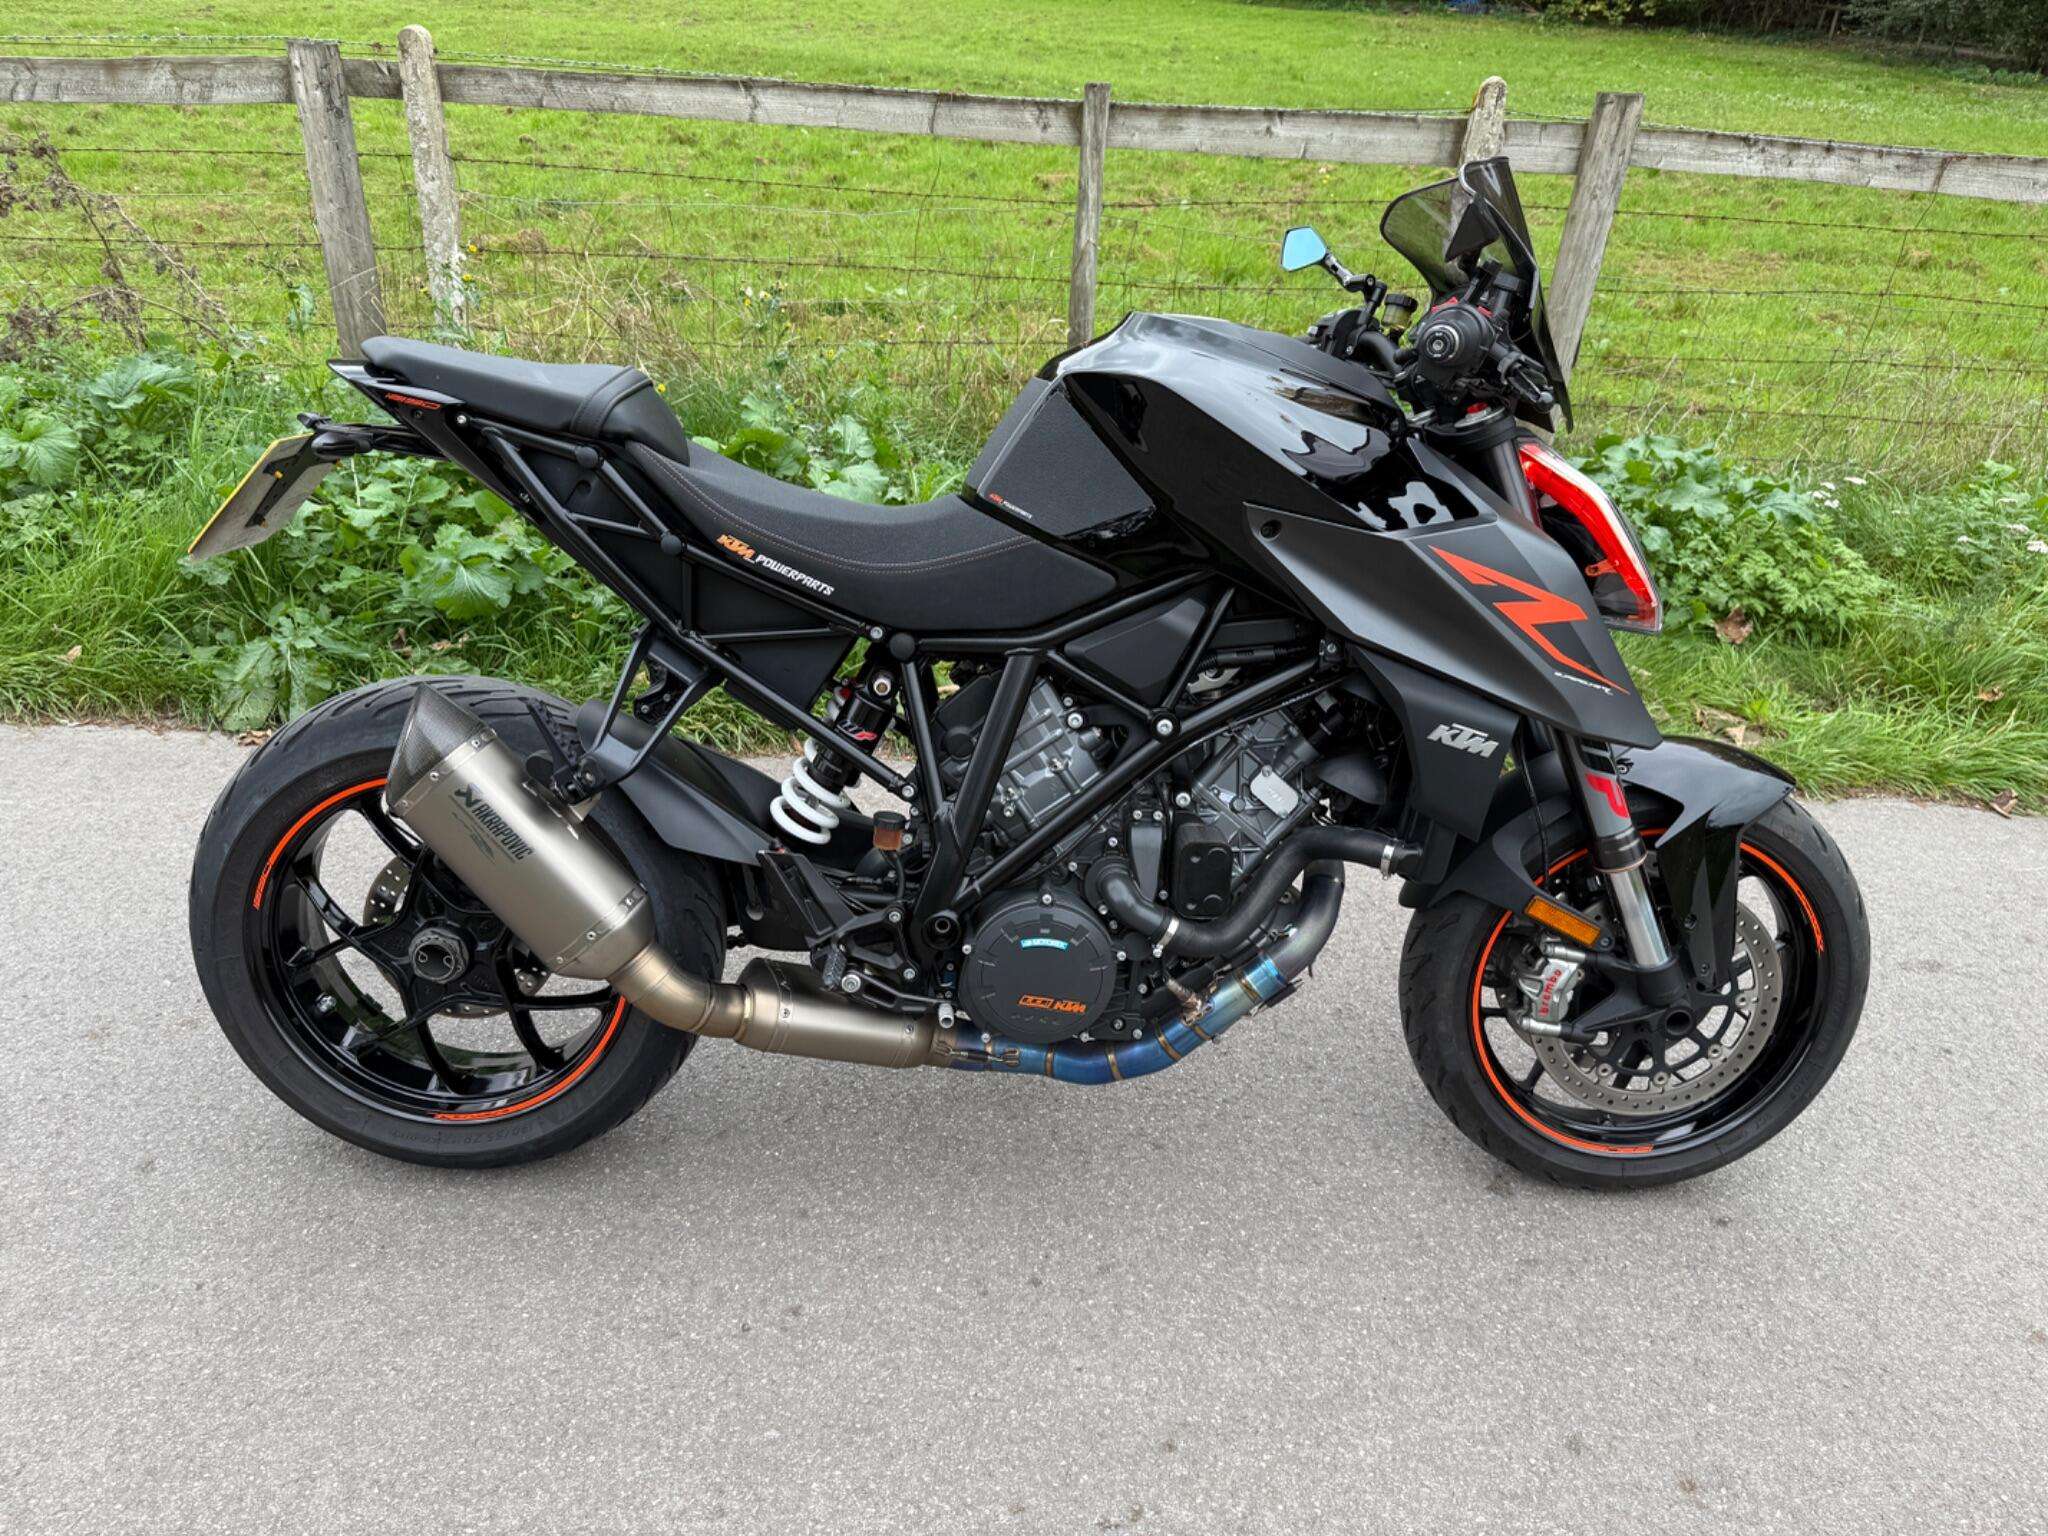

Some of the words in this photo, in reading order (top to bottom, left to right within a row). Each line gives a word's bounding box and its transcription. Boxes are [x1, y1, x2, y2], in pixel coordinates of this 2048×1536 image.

[716, 534, 756, 560] KTM
[755, 554, 835, 596] POWERPARTS
[1426, 723, 1499, 758] KTM
[1538, 969, 1562, 1017] brembo
